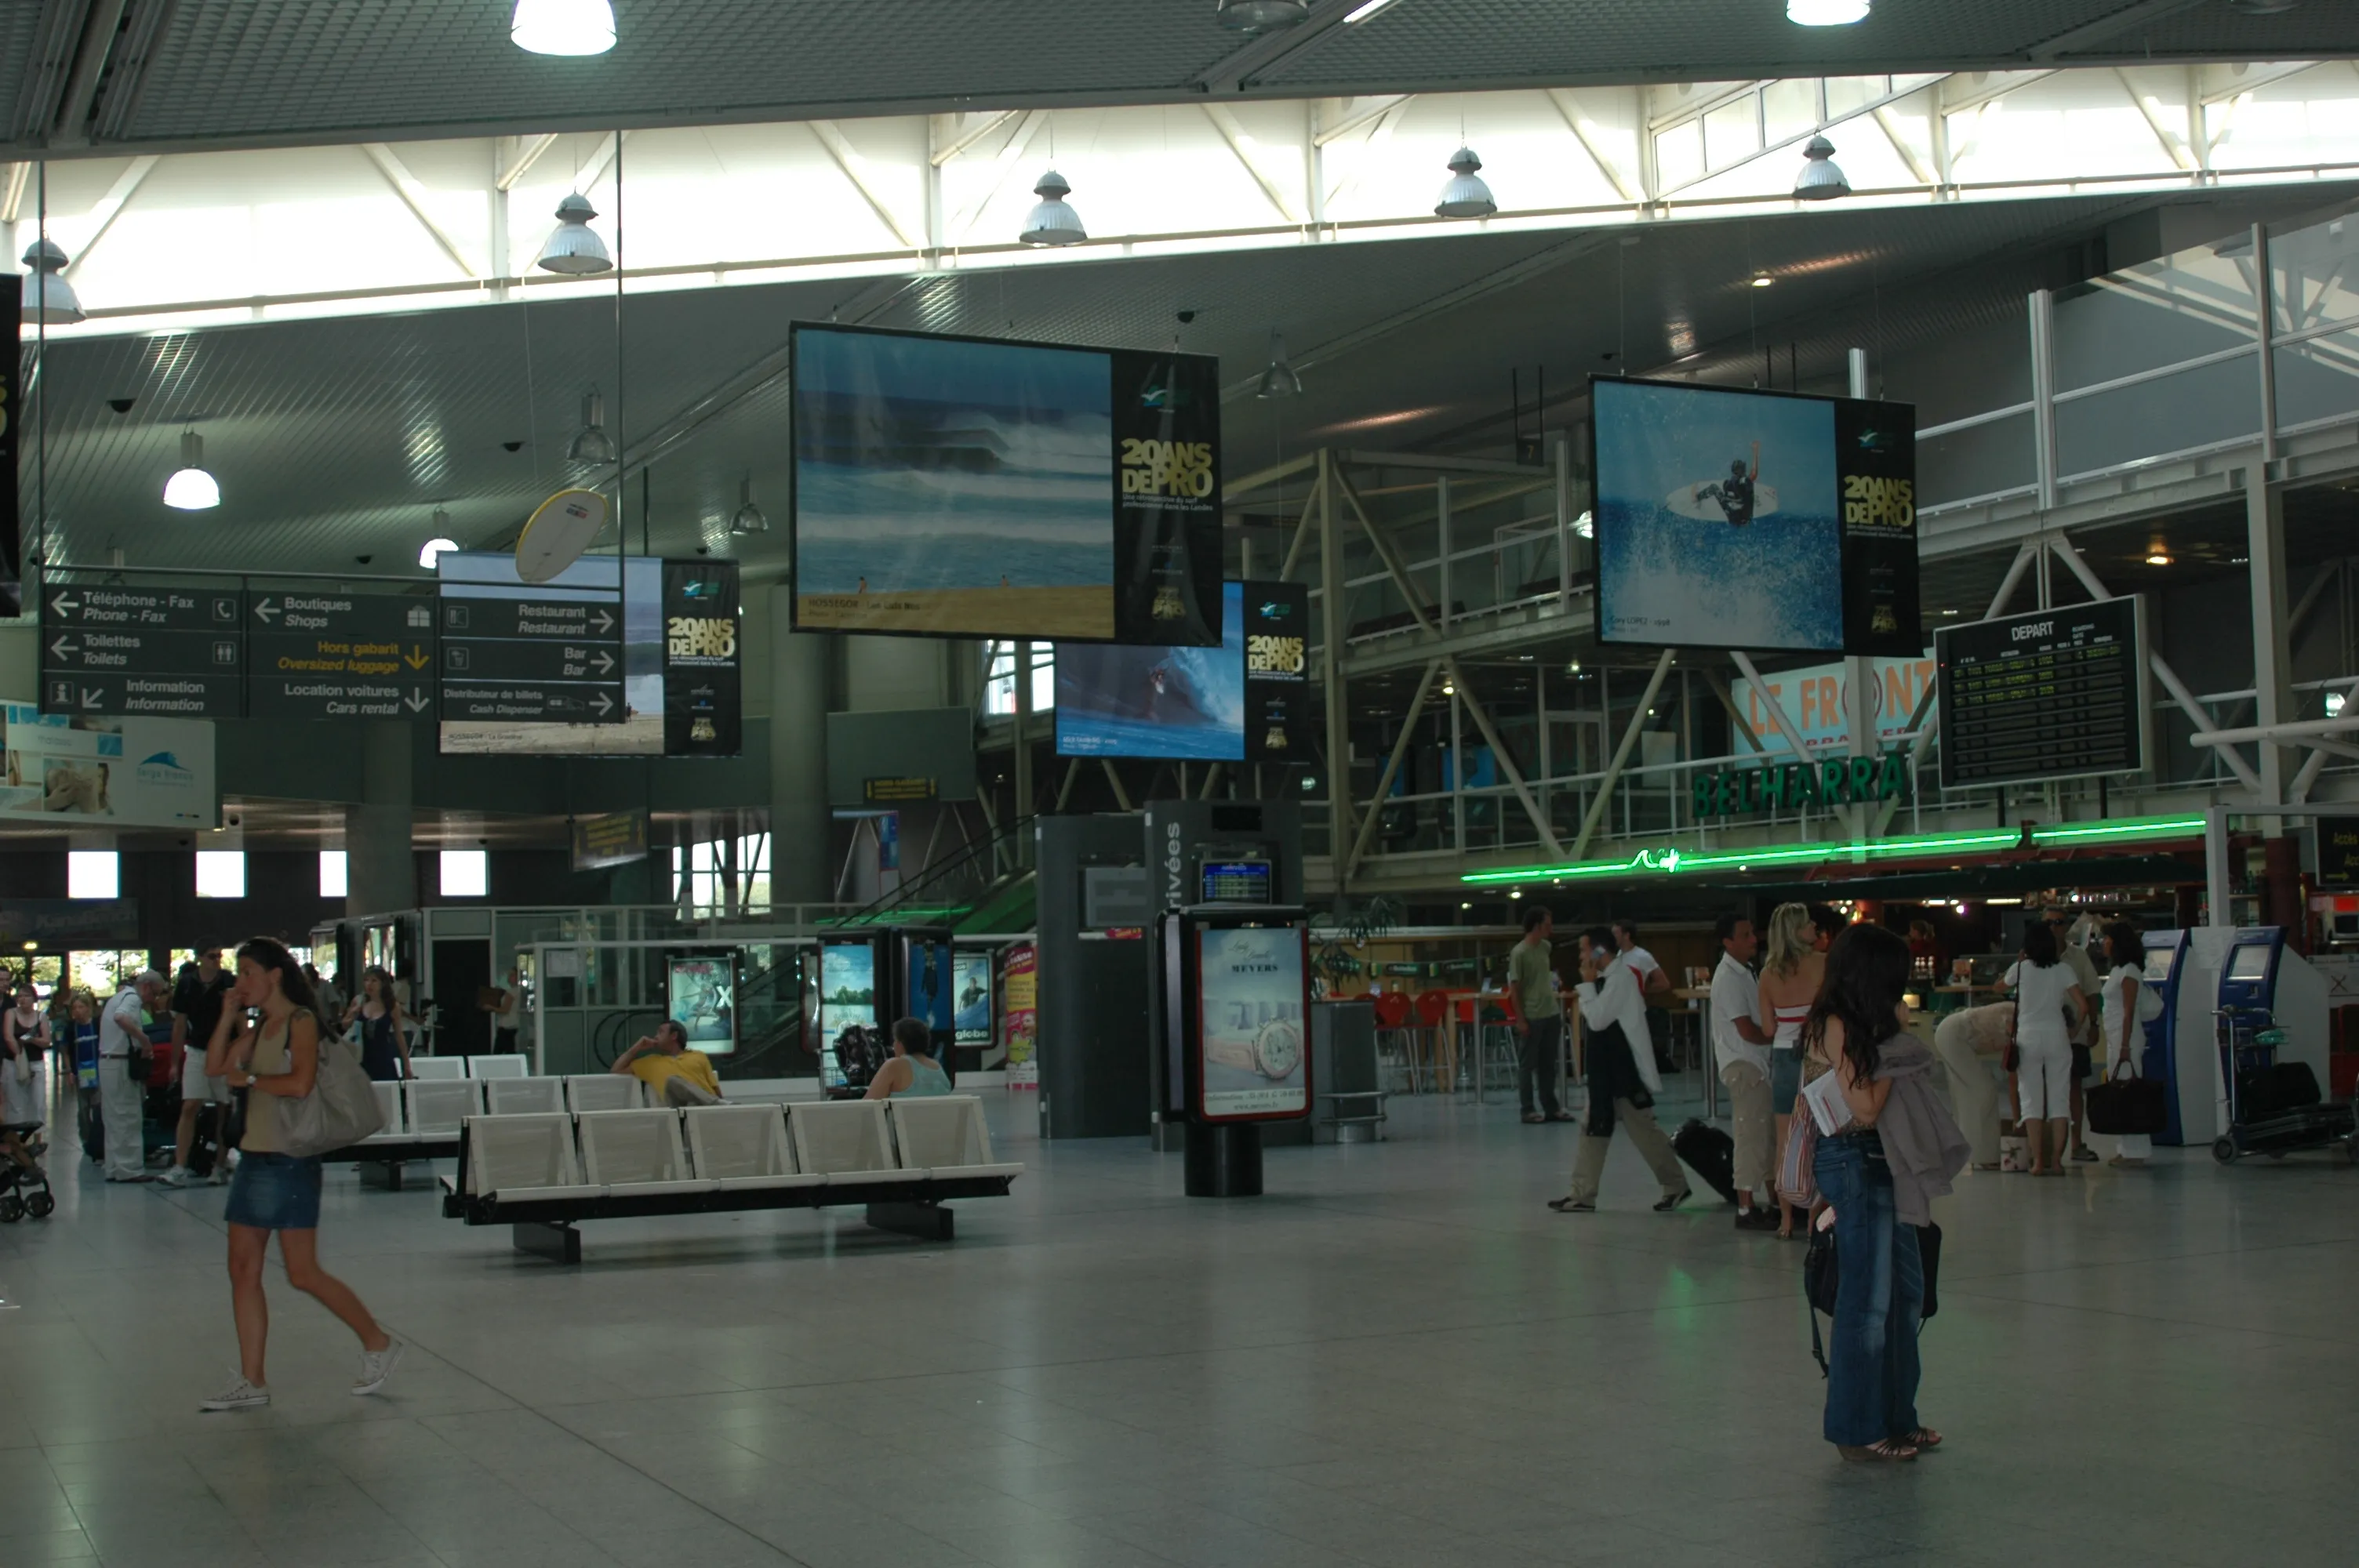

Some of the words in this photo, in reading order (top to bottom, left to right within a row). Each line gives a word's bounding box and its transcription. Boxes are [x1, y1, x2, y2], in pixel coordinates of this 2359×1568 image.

[82, 590, 157, 608] Téléphone
[169, 595, 194, 608] Fax
[284, 597, 352, 613] Boutiques
[82, 607, 129, 622] Phone
[140, 609, 167, 622] Fax
[518, 603, 587, 619] Restaurant
[285, 614, 329, 629] Shops
[518, 621, 587, 635] Restaurant
[2011, 621, 2055, 641] DEPART
[82, 633, 141, 648] Toilettes
[318, 641, 350, 654] Hors
[352, 642, 399, 657] gabarit
[564, 647, 587, 660] Bar
[82, 652, 128, 666] Toilets
[278, 656, 345, 671] Oversized
[347, 659, 400, 674] luggage
[562, 663, 587, 676] Bar
[125, 679, 205, 694] Information
[284, 682, 343, 697] Location
[347, 684, 400, 698] voitures
[443, 688, 499, 699] Distributeur
[500, 688, 514, 699] de
[514, 689, 543, 700] billets
[125, 696, 205, 711] Information
[325, 700, 358, 714] Cars
[361, 702, 400, 715] rental
[469, 703, 494, 714] Cash
[496, 704, 543, 716] Dispenser
[1692, 750, 1906, 818] BELHARRA
[1164, 822, 1182, 909] rivées
